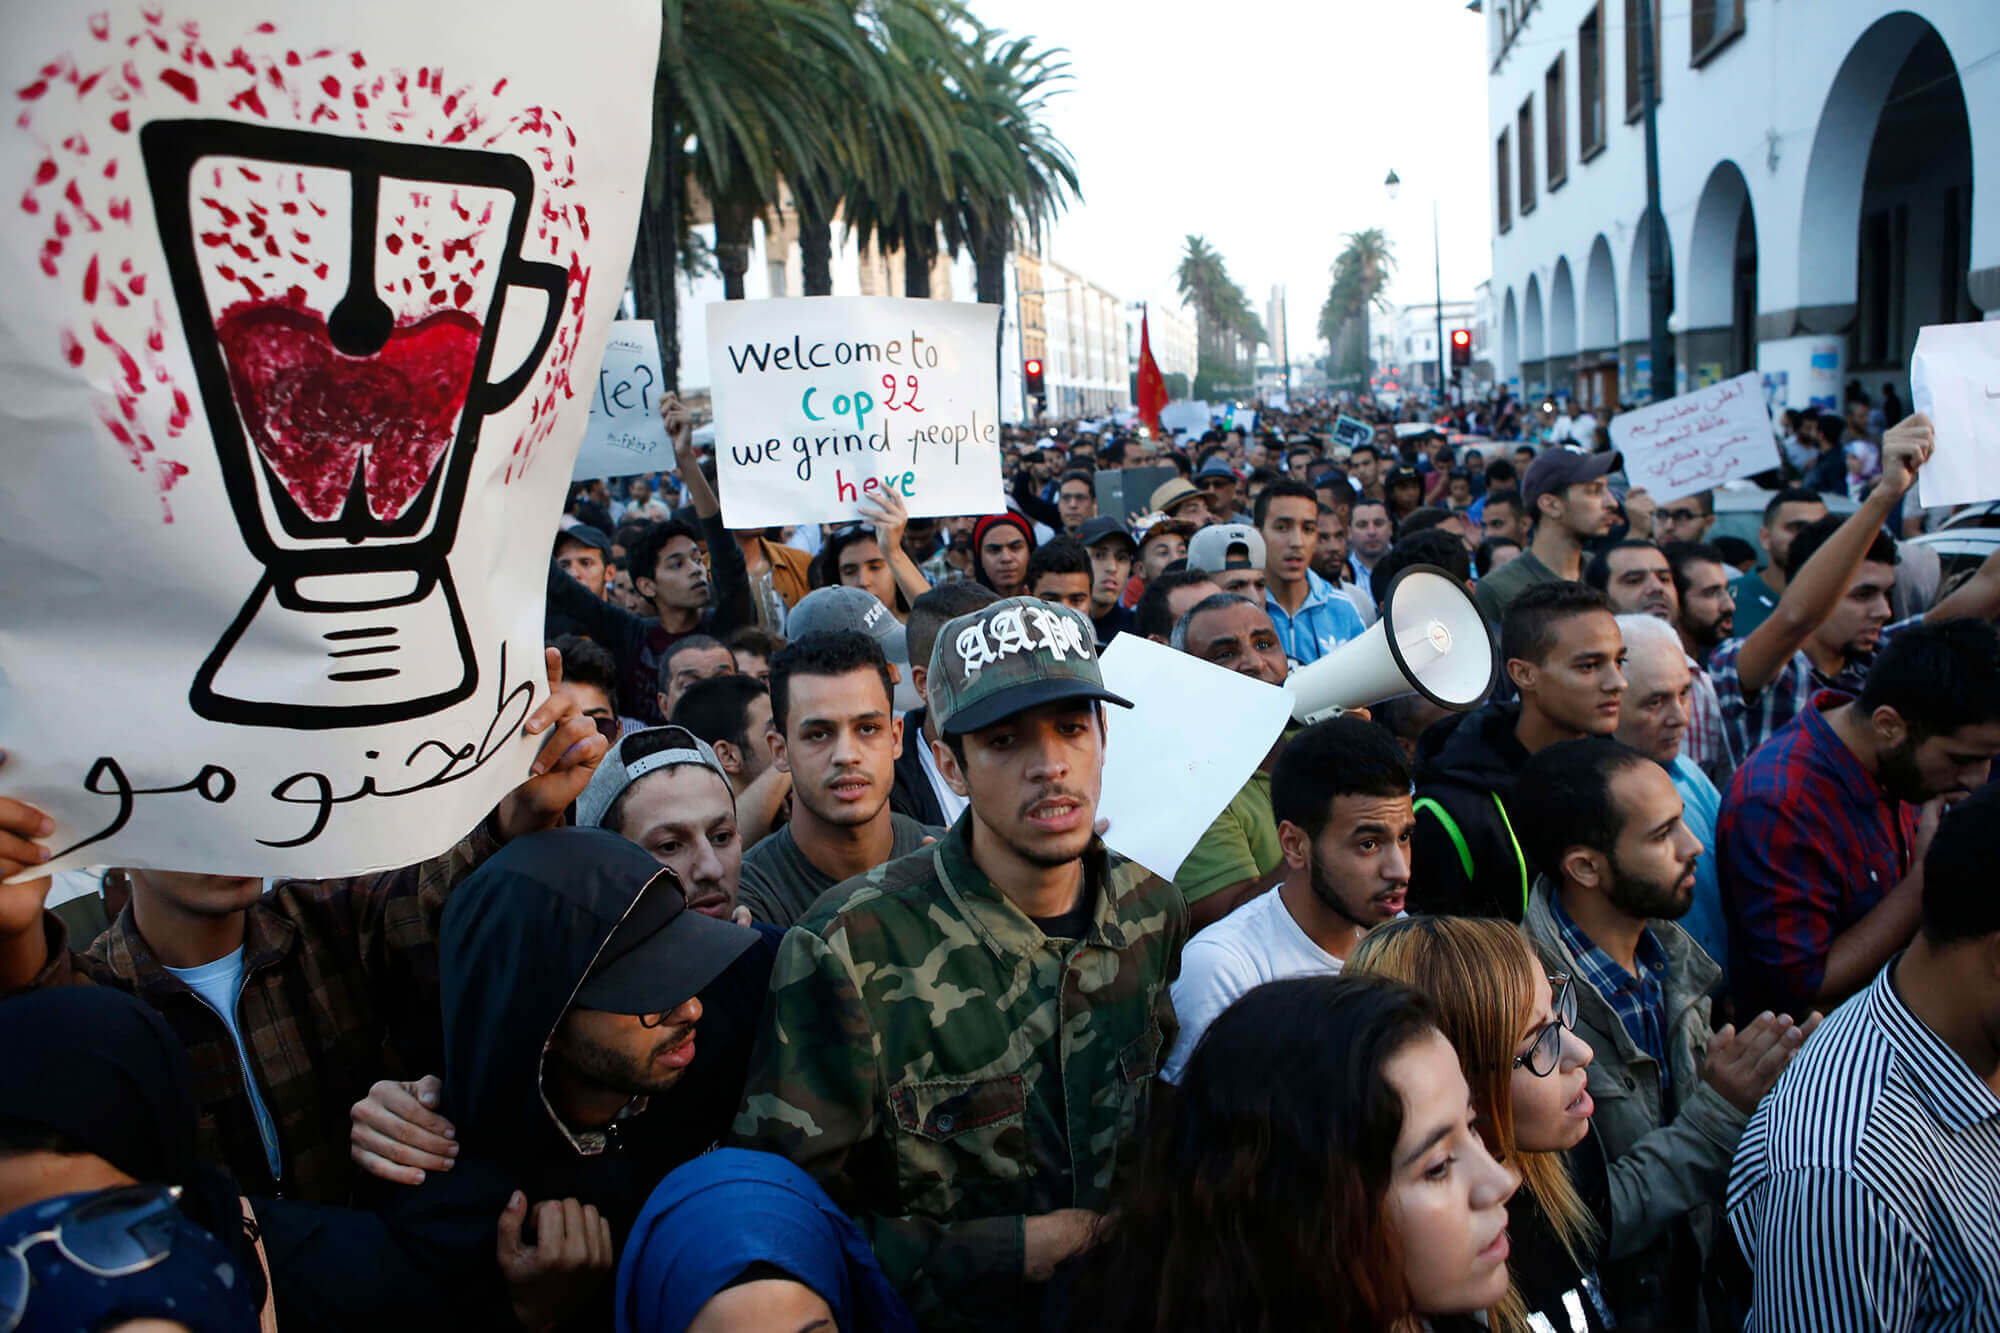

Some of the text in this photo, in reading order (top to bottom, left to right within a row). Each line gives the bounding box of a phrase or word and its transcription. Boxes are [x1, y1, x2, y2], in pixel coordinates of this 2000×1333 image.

[728, 329, 938, 374] Welcome to
[732, 410, 996, 481] we grind people
[836, 470, 916, 502] here
